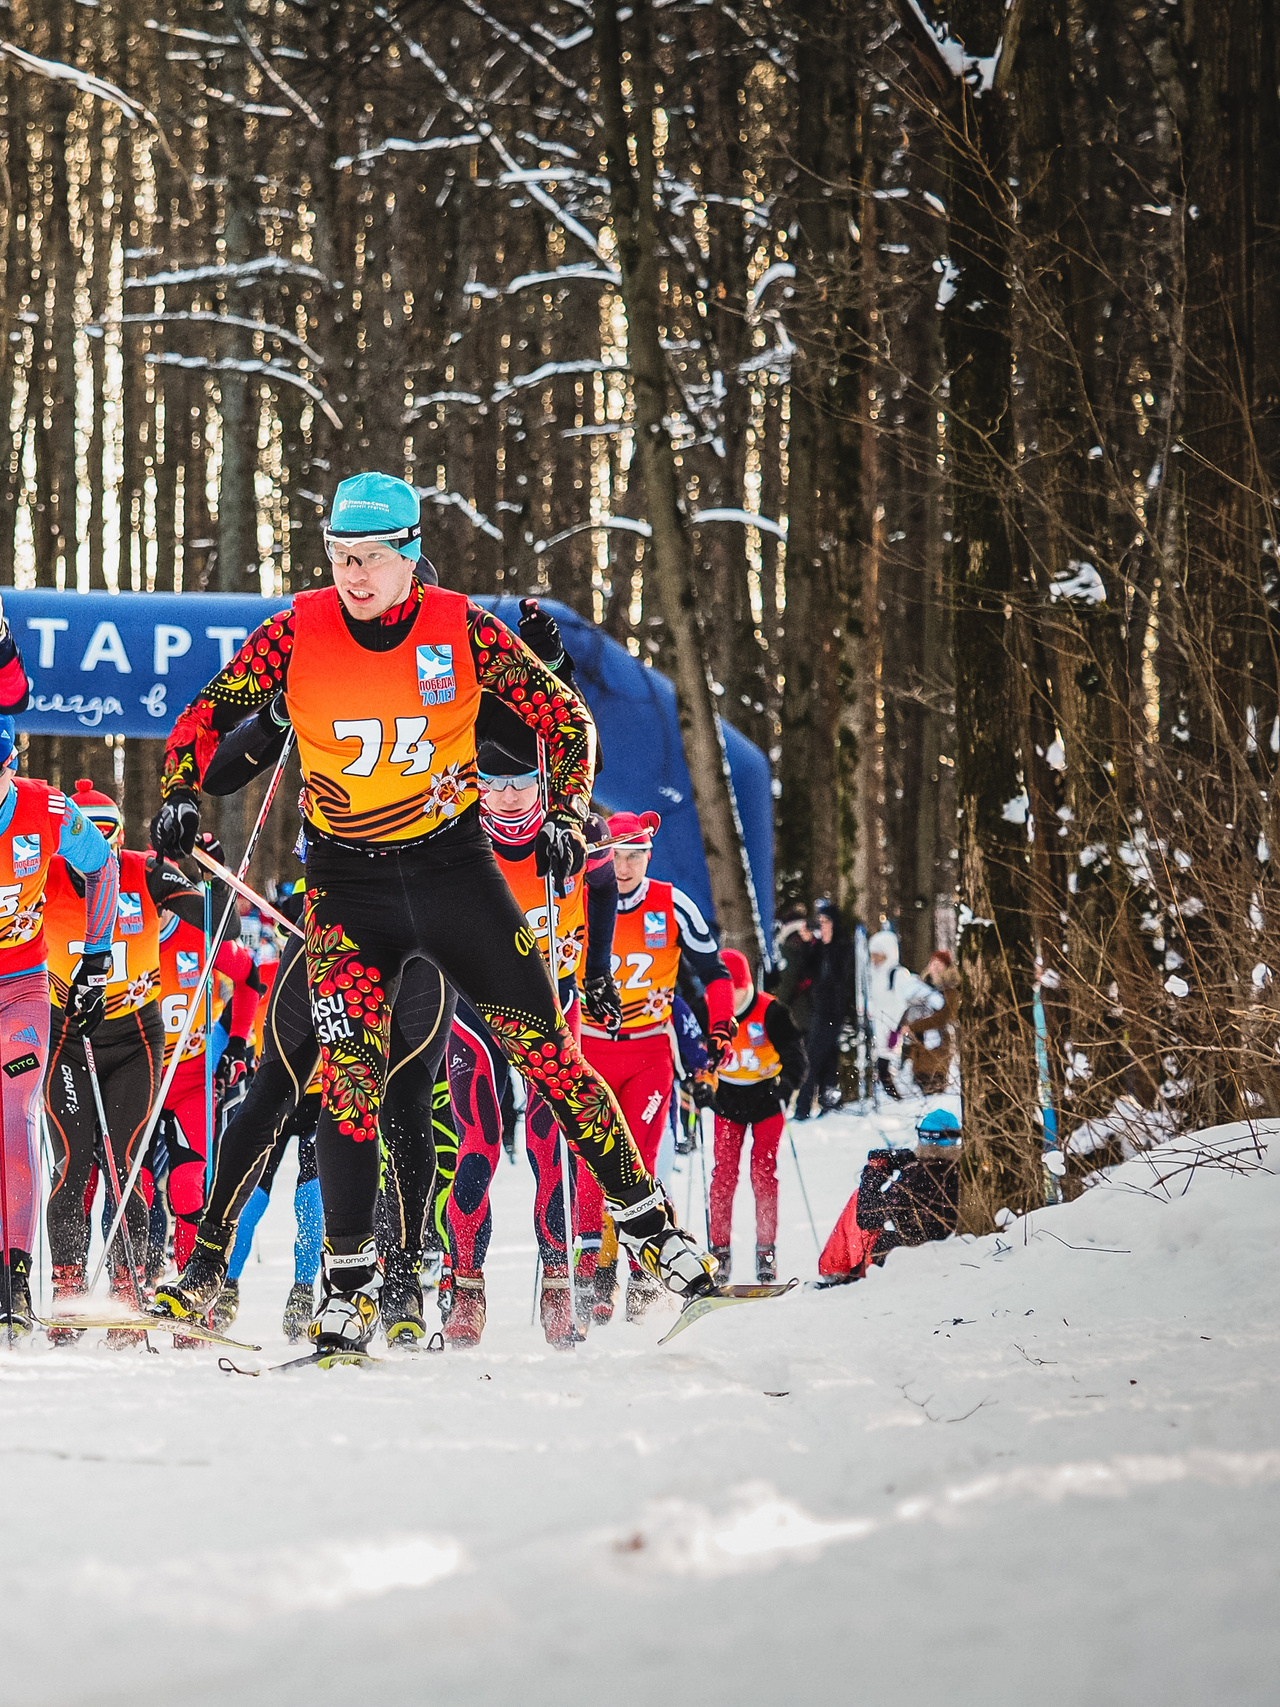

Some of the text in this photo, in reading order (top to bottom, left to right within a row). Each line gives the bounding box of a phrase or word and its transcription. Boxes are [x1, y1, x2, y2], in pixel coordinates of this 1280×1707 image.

[419, 676, 455, 692] ПОБЕДА!
[421, 688, 455, 706] 70 ЛЕТ
[332, 716, 436, 777] 74
[318, 1013, 354, 1044] ski
[61, 1064, 78, 1105] CRAFT
